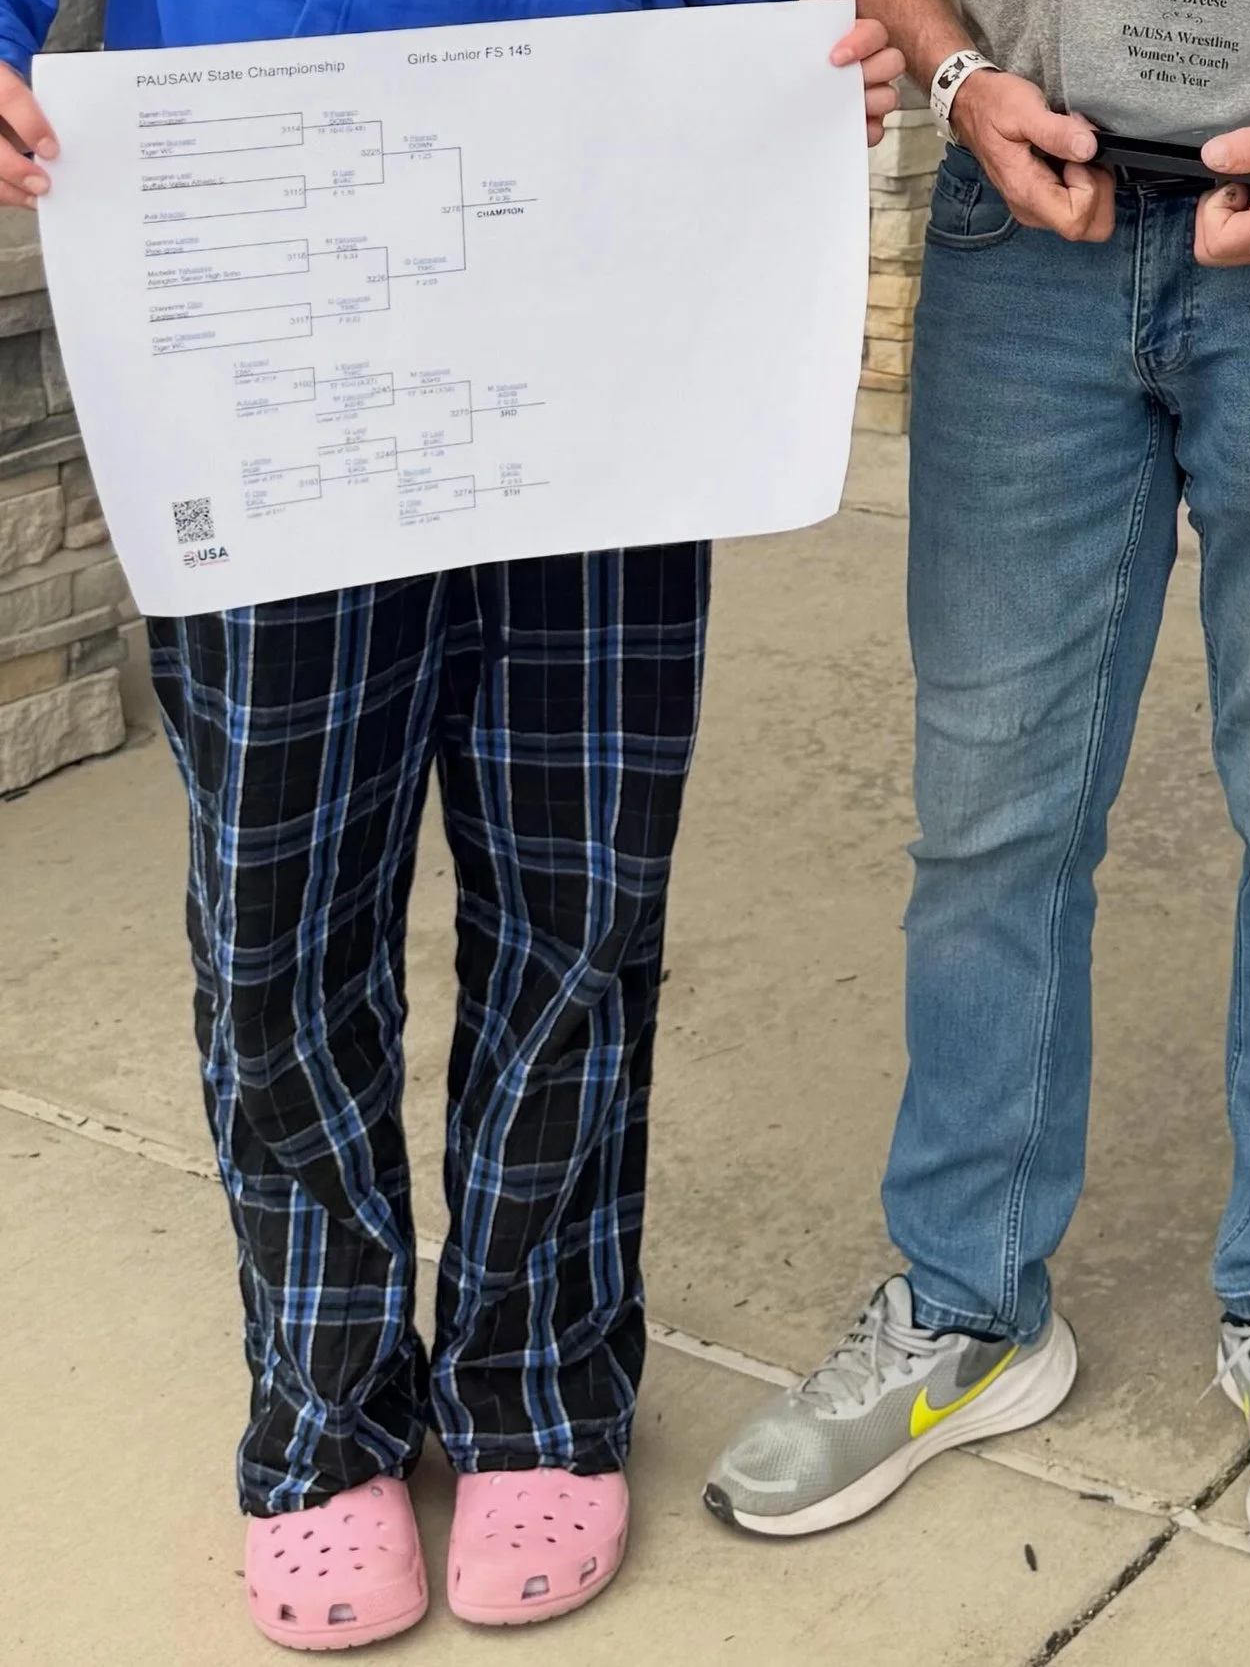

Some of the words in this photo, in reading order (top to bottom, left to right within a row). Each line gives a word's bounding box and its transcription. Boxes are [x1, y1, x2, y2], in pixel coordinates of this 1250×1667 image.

[1122, 24, 1173, 42] PA/USA
[1178, 32, 1240, 52] Wrestling
[407, 53, 438, 65] Girls
[442, 50, 480, 62] Junior
[485, 47, 504, 59] FS
[509, 44, 532, 57] 145
[1127, 45, 1185, 64] Women's
[1189, 53, 1230, 70] Coach
[137, 72, 203, 87] PAUSAW
[208, 69, 243, 82] State
[248, 61, 345, 79] Championship
[1140, 69, 1153, 80] of
[1156, 70, 1177, 83] the
[1181, 74, 1210, 88] Year
[198, 547, 229, 561] USA
